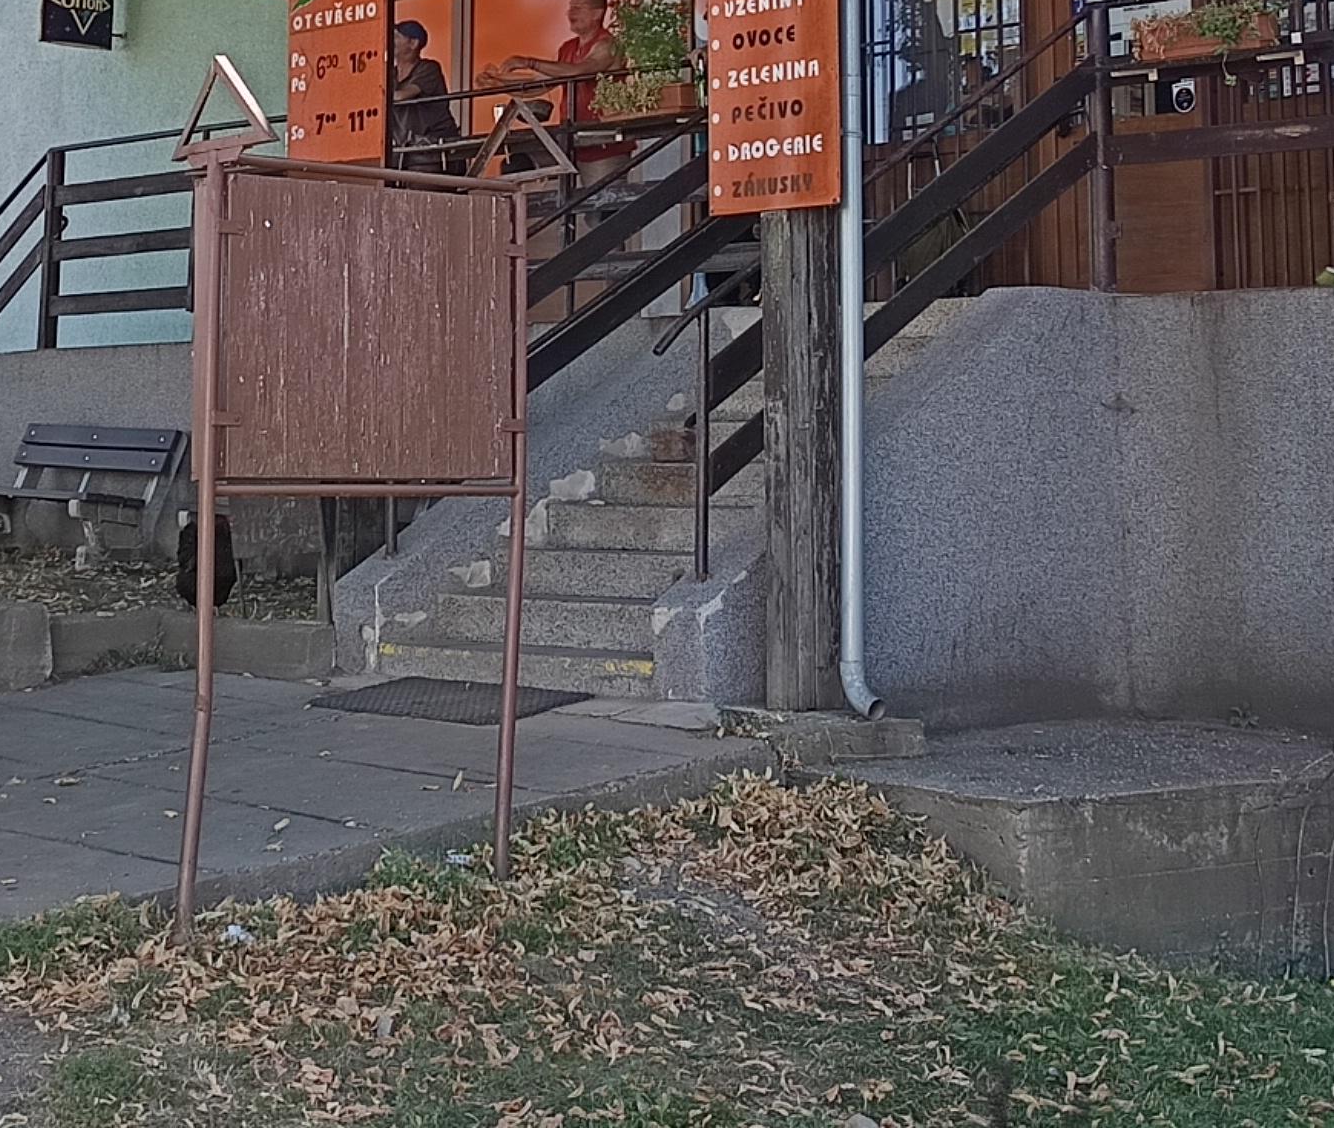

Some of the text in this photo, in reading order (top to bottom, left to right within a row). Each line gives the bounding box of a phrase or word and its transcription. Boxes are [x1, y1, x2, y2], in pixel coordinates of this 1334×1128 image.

[292, 1, 377, 31] OTEVŘENO
[732, 24, 796, 50] OVOCE
[291, 52, 306, 68] Po
[727, 59, 819, 88] ZELENINA
[291, 73, 306, 92] Pá
[732, 95, 803, 124] PEČIVO
[290, 125, 305, 141] So
[727, 133, 823, 162] DROGERIE
[732, 172, 813, 199] ZÁKUSKY
